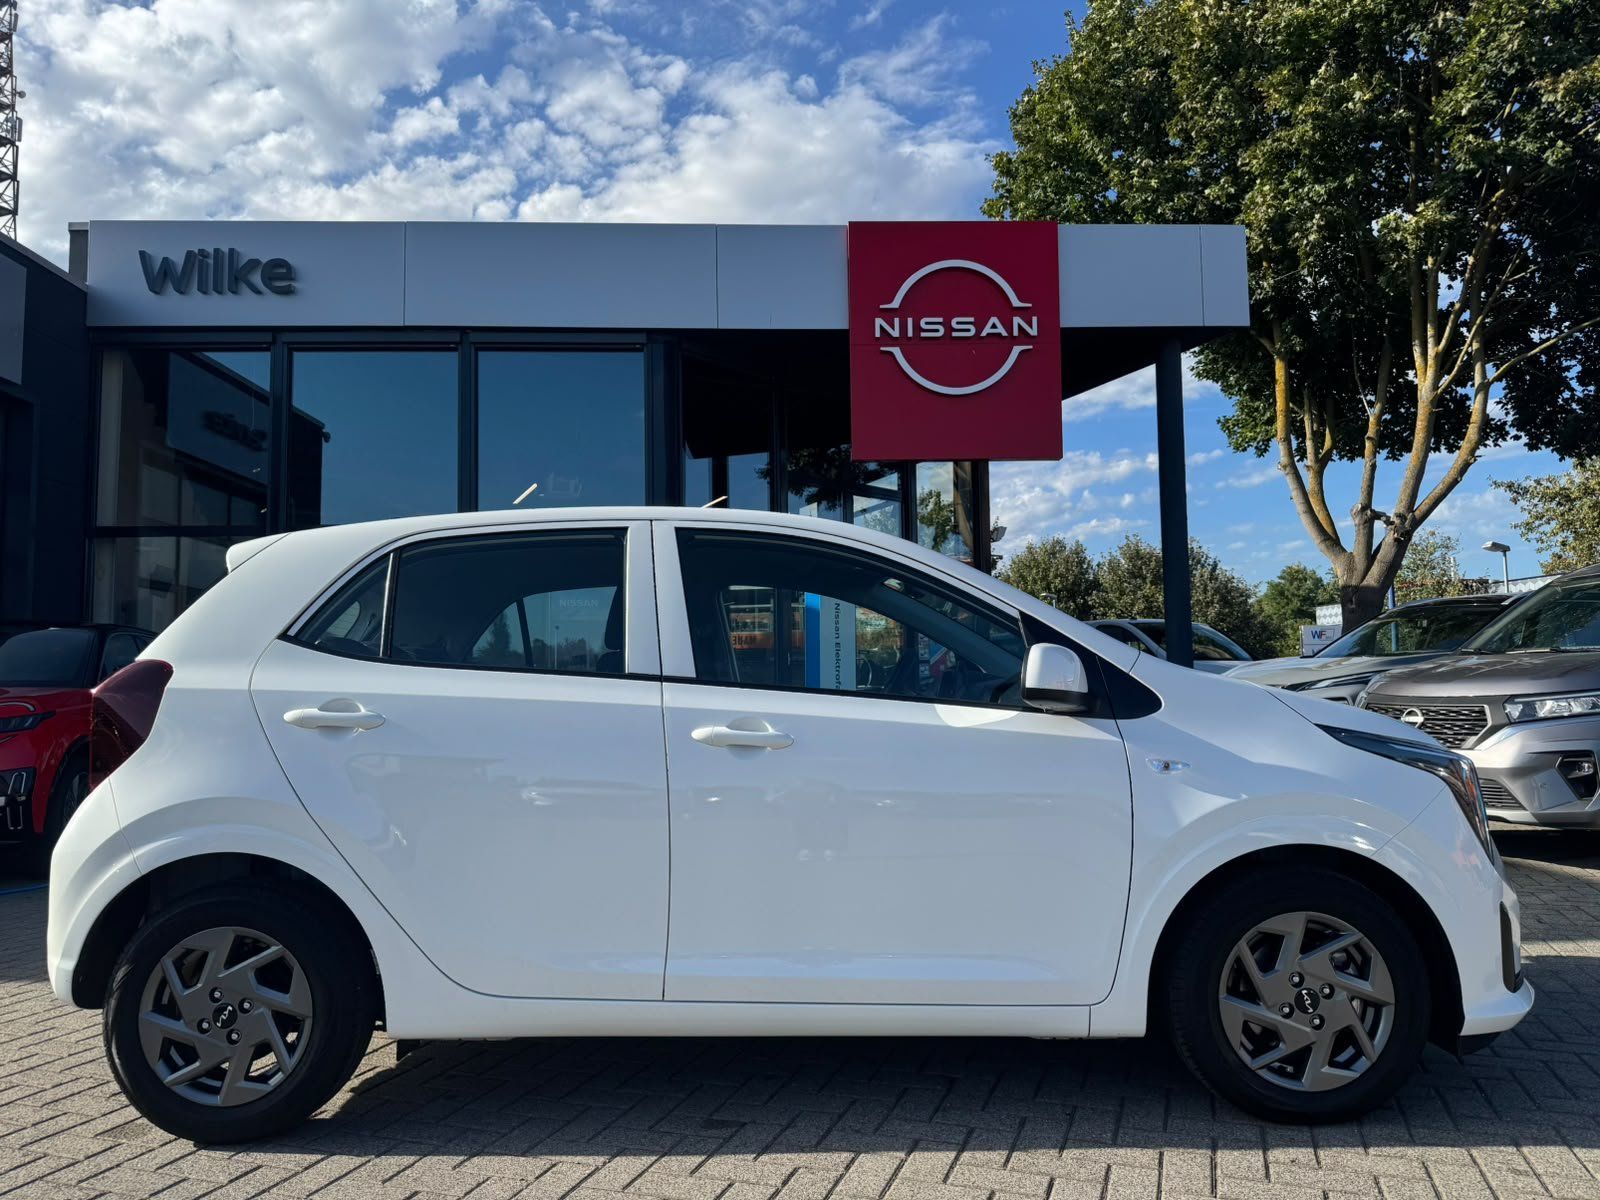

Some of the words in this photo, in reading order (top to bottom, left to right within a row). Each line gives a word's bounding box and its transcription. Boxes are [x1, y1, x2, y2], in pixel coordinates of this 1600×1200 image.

[138, 247, 296, 295] Wilke
[874, 316, 1038, 337] NISSAN
[560, 599, 600, 608] NISSAN
